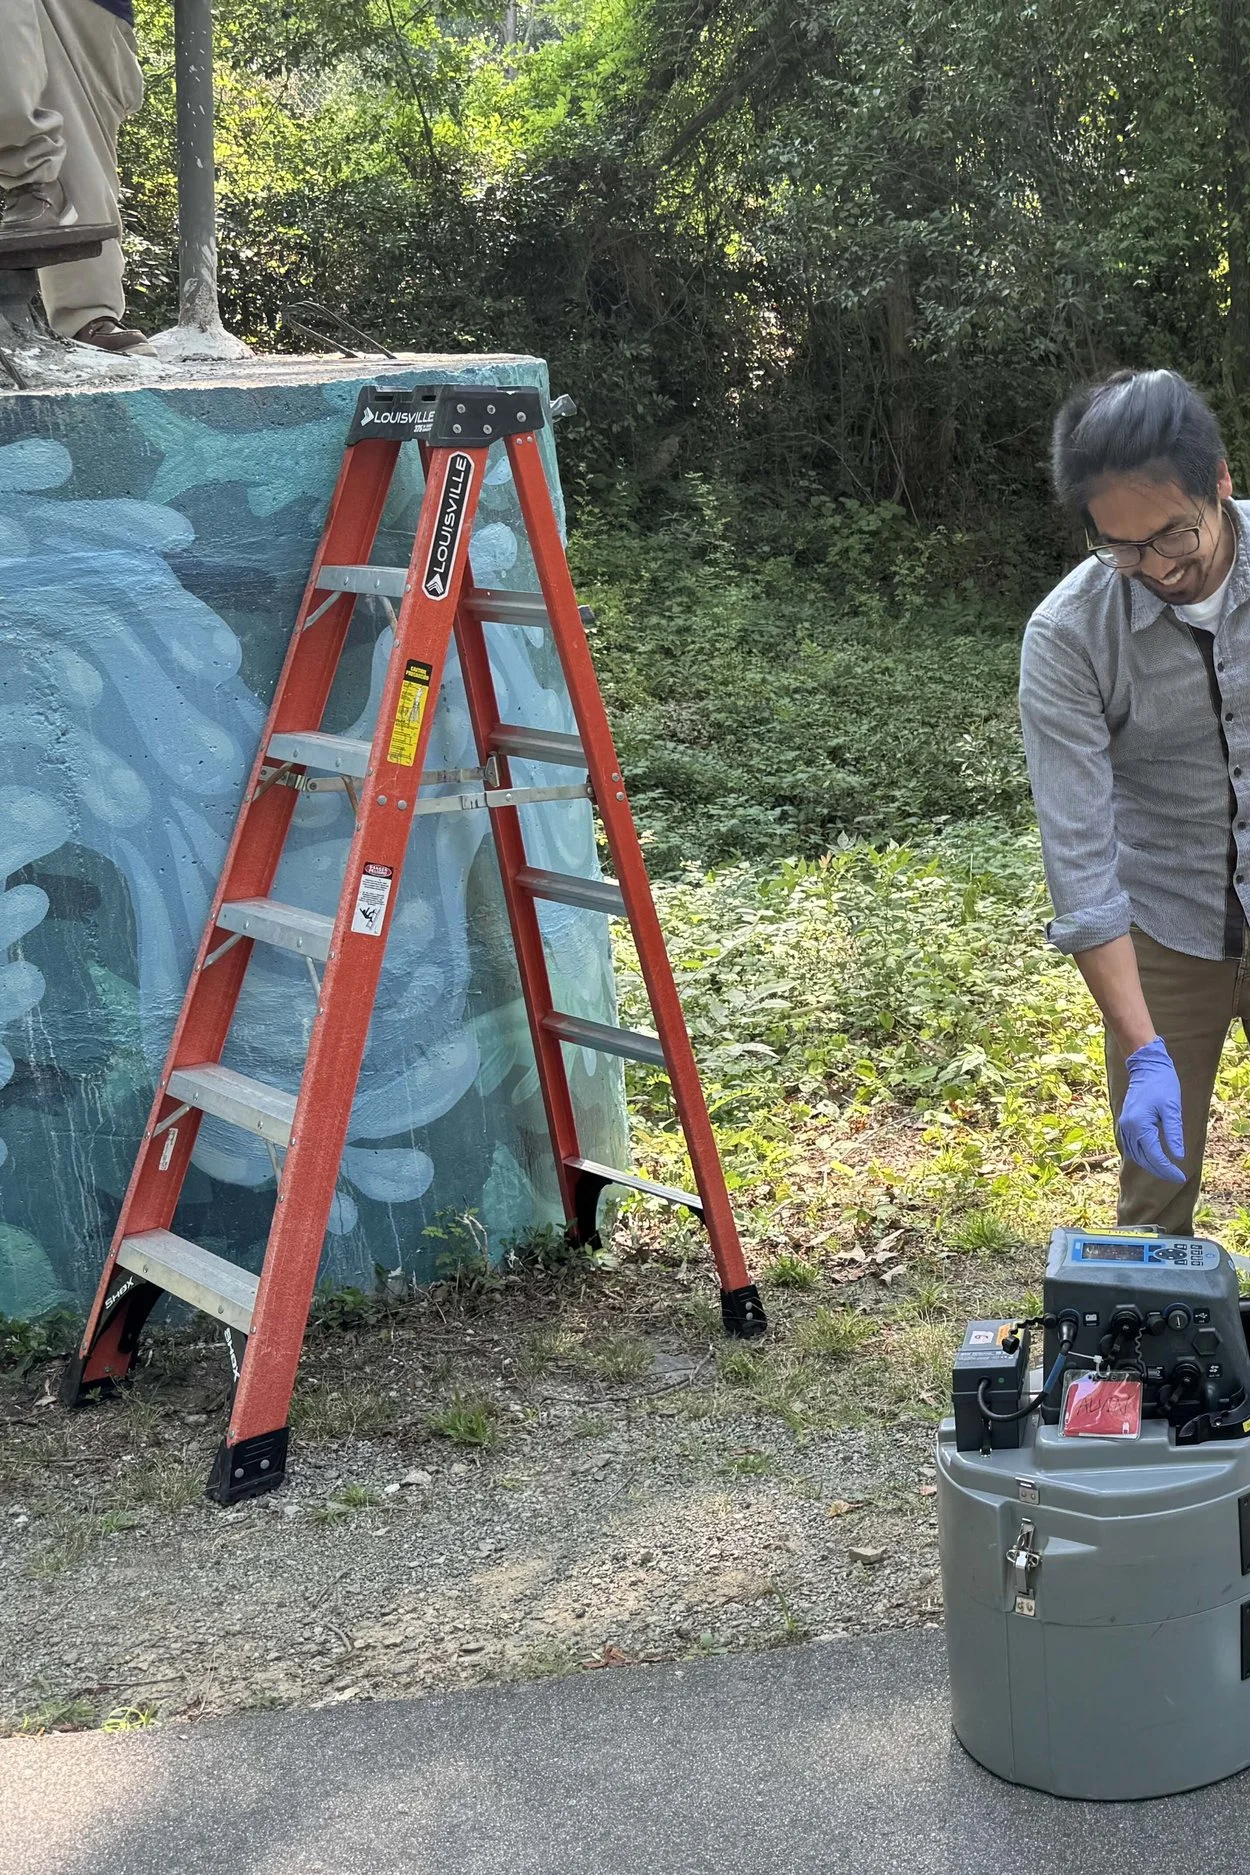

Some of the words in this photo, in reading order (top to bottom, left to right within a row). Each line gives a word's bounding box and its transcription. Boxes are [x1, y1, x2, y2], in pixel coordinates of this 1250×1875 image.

[374, 411, 436, 424] LOUISVILLE
[433, 456, 467, 573] LOUISVILLE
[105, 1276, 134, 1310] SHOX
[224, 1327, 241, 1383] SHOX
